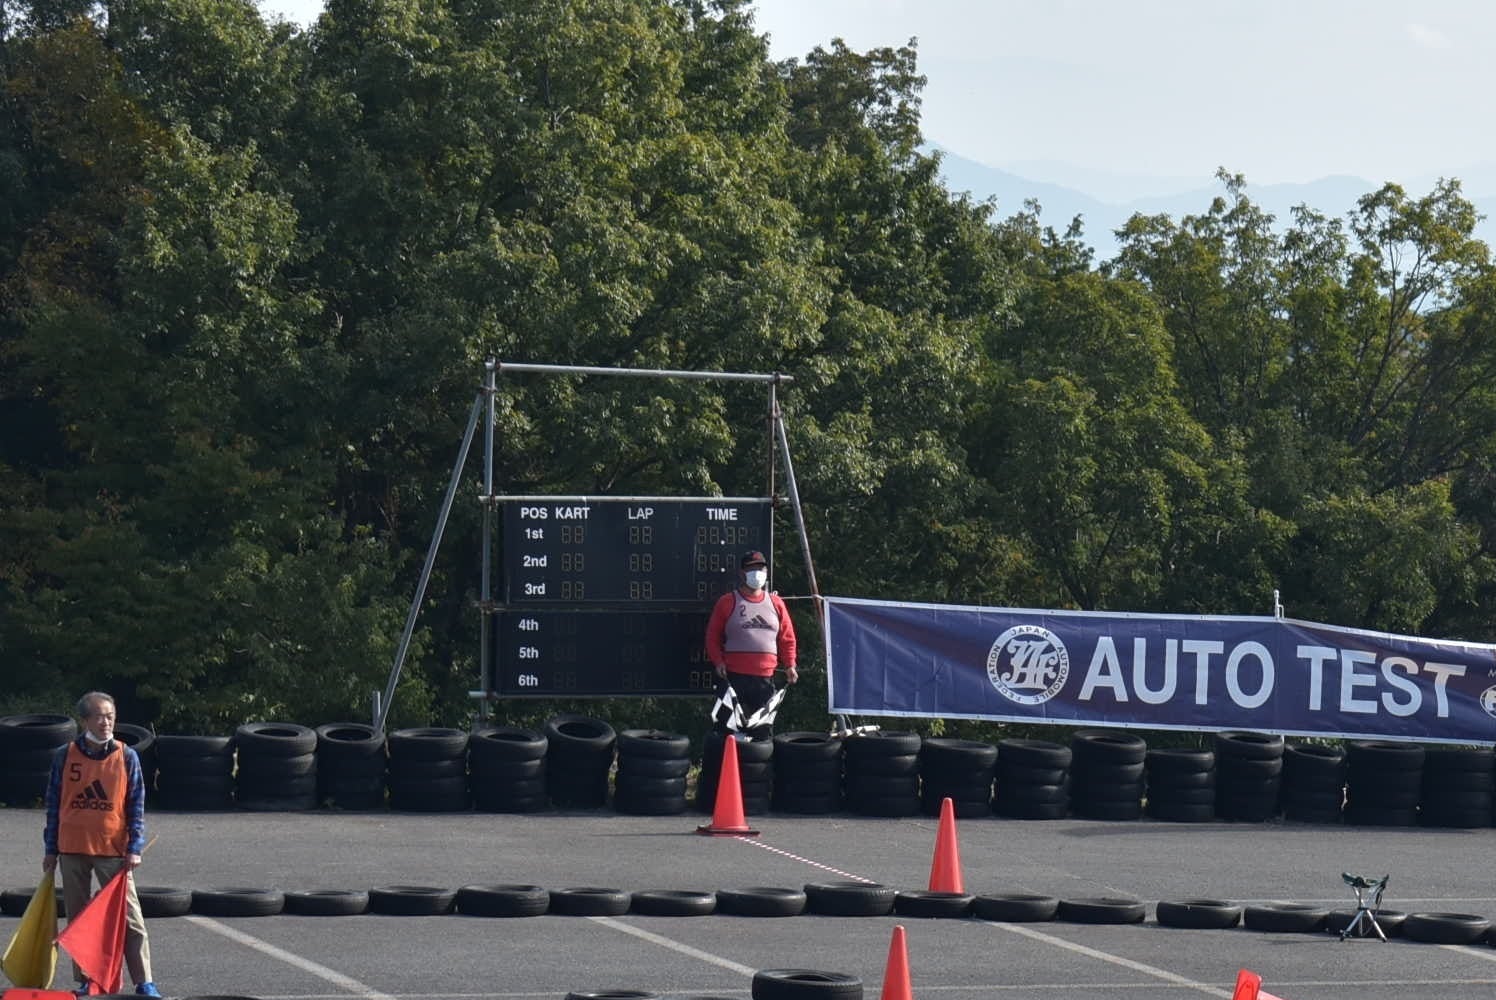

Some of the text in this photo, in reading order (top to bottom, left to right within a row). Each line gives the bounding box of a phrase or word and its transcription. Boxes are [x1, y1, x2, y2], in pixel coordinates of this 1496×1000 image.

[520, 506, 738, 521] POS KART LAP TIME
[525, 527, 544, 539] 1st
[523, 554, 547, 567] 2nd
[524, 582, 546, 595] 3rd
[518, 618, 539, 631] 4th
[1010, 626, 1050, 638] JAPAN
[519, 646, 539, 659] 5th
[518, 674, 538, 686] 6th
[1078, 636, 1467, 718] AUTO TEST
[70, 762, 82, 782] 5
[71, 799, 114, 811] adidas
